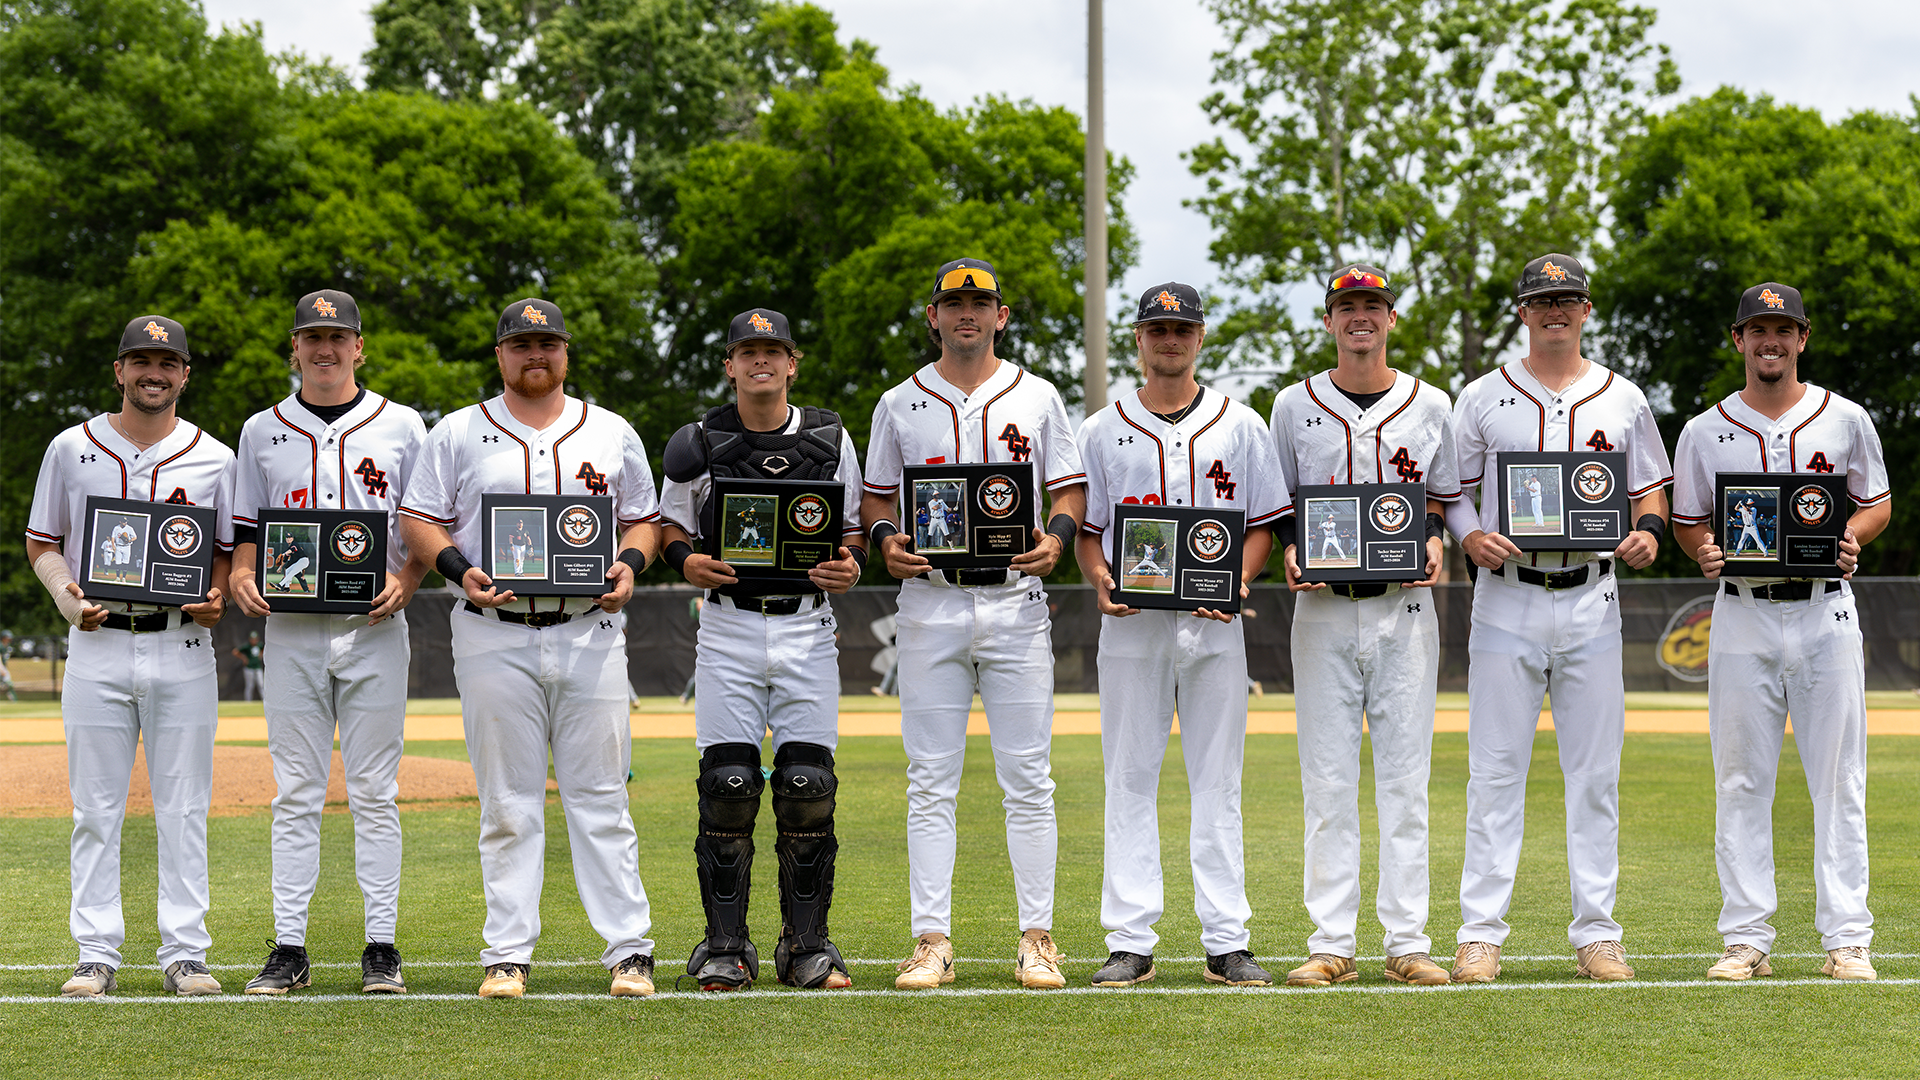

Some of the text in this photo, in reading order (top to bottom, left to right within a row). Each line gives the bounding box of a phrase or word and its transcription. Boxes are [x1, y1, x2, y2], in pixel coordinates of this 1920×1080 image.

[1539, 261, 1566, 281] AUM
[312, 297, 337, 318] AUM
[1157, 290, 1180, 312] AUM
[1758, 288, 1784, 309] AUM
[521, 305, 548, 325] AUM
[748, 313, 773, 332] AUM
[143, 321, 168, 343] AUM
[998, 423, 1032, 462] AUM
[1388, 447, 1423, 483] AUM
[354, 457, 388, 499] AUM
[1206, 459, 1237, 500] AUM
